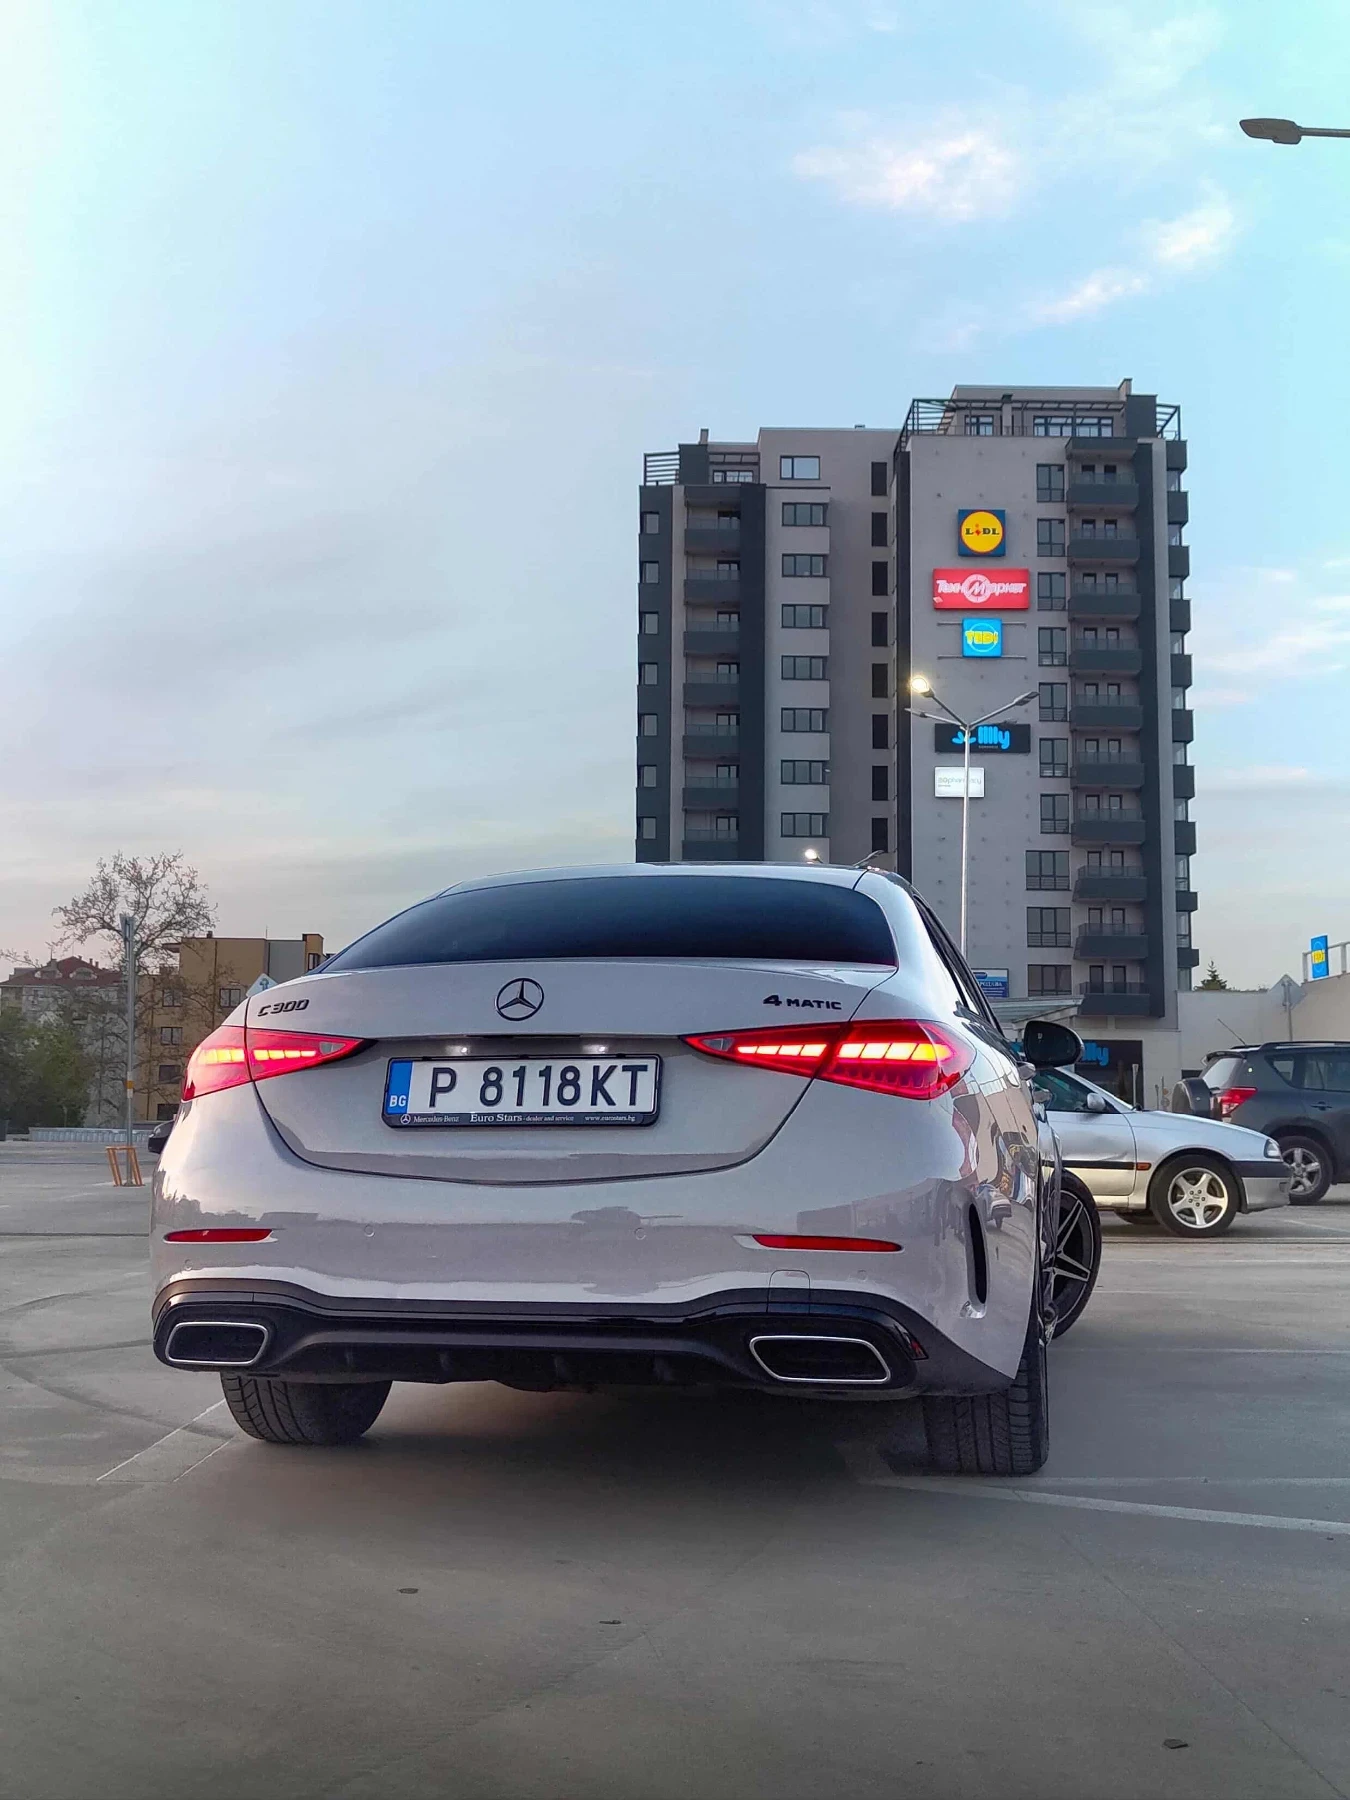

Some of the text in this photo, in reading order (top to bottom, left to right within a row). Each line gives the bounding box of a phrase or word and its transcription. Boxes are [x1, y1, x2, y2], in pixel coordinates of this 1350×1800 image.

[977, 725, 1010, 750] lilly
[429, 1067, 457, 1108] P
[389, 1095, 407, 1108] BG
[470, 1113, 495, 1122] Euro
[496, 1113, 522, 1122] Stars
[585, 1114, 636, 1123] www.eurostars.bg
